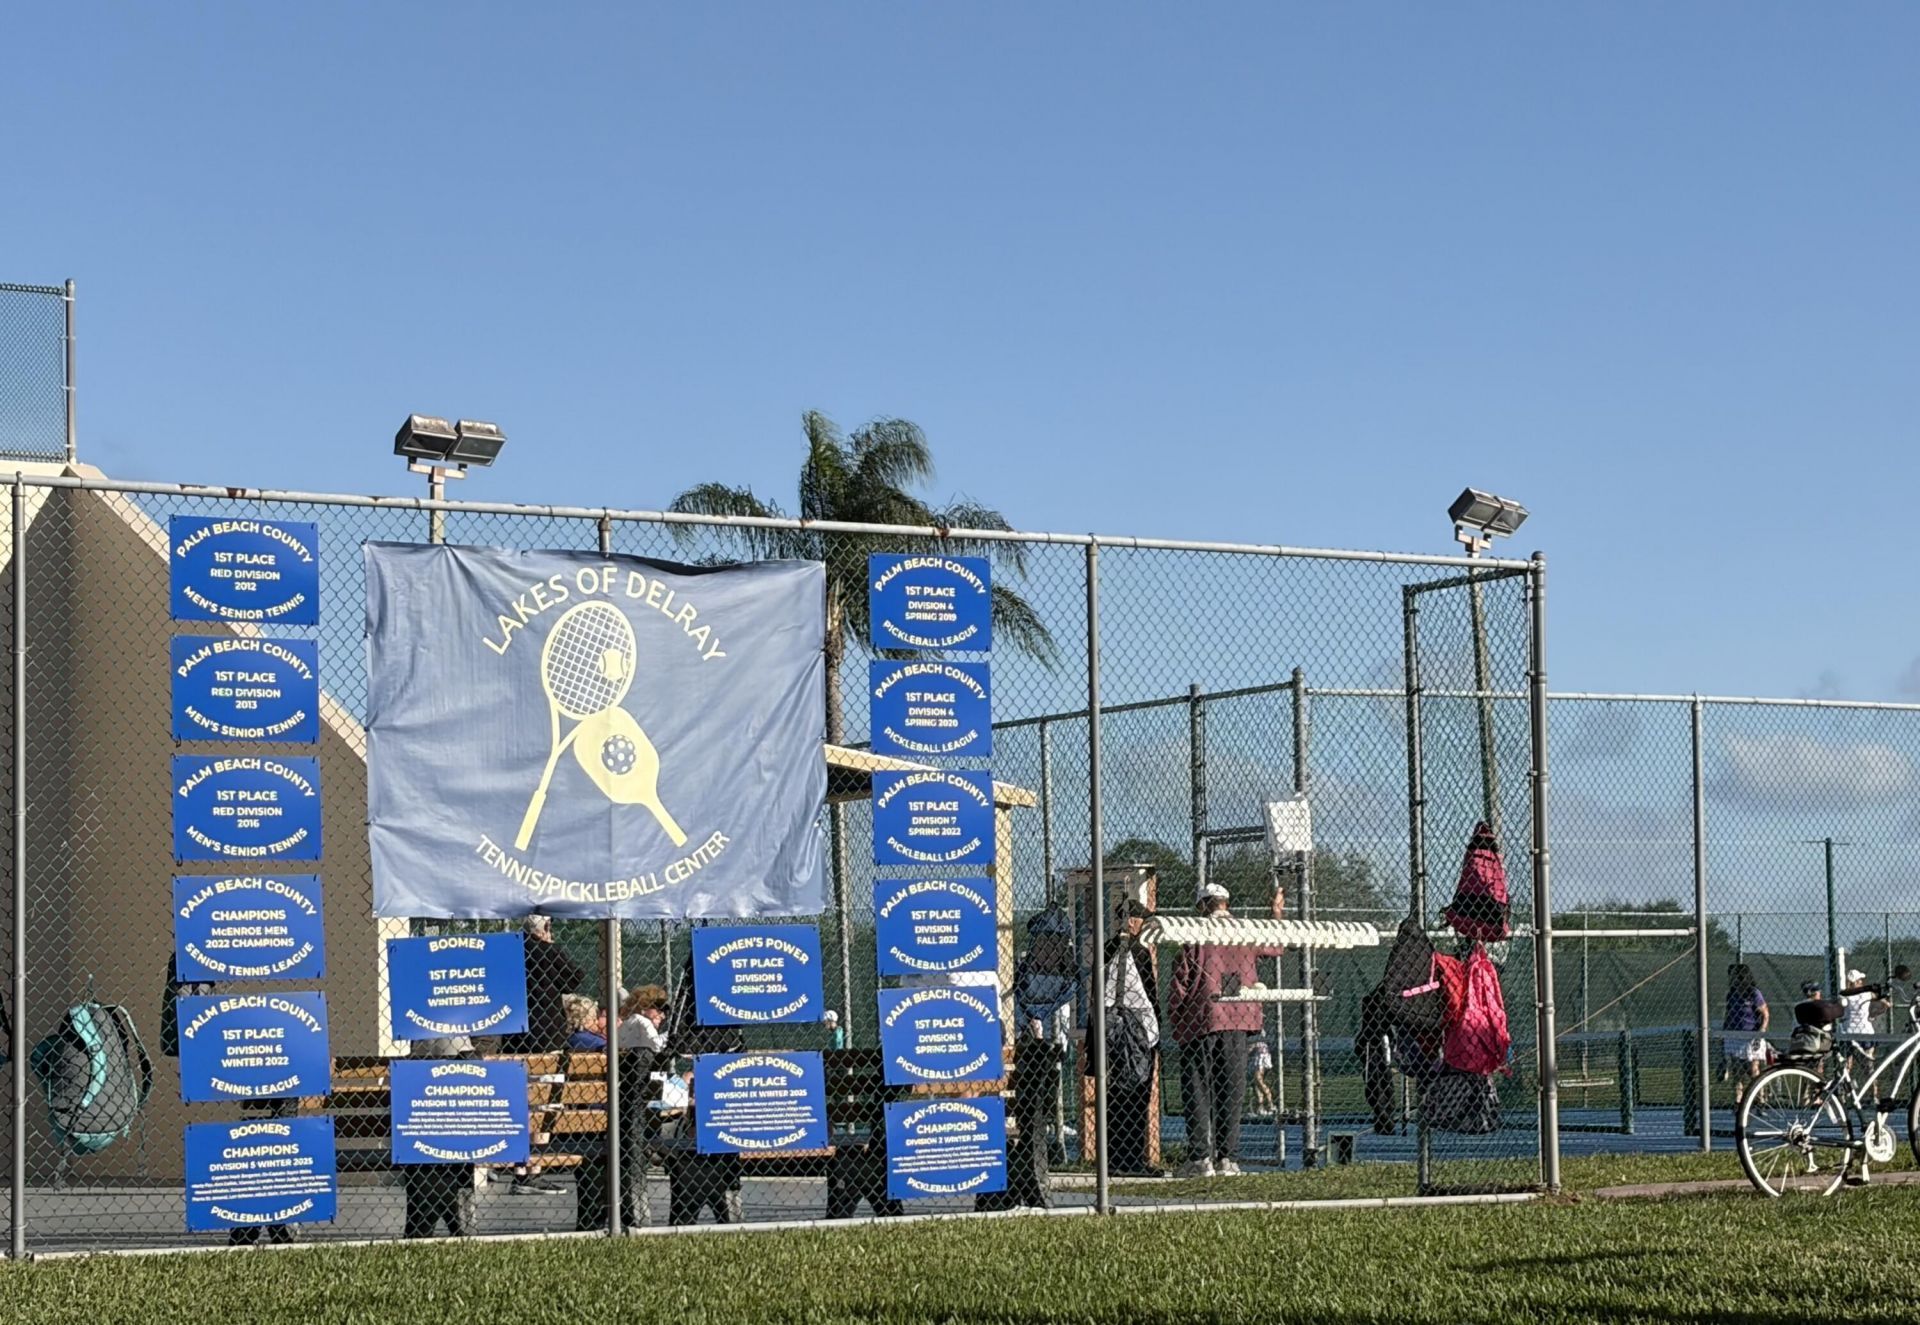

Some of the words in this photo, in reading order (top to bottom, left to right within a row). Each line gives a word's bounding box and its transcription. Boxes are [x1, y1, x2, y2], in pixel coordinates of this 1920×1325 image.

[177, 528, 211, 557] PALM
[212, 521, 259, 534] BEACH
[263, 526, 313, 563] COUNTY
[214, 552, 233, 562] 1ST
[237, 554, 275, 565] PLACE
[210, 568, 232, 577] RED
[235, 570, 280, 580] DIVISION
[875, 563, 902, 591] PALM
[904, 558, 942, 570] BEACH
[945, 561, 986, 594] COUNTY
[234, 582, 257, 591] 2012
[905, 586, 921, 596] 1ST
[924, 587, 955, 596] PLACE
[183, 586, 218, 613] MEN'S
[220, 606, 263, 619] SENIOR
[266, 593, 305, 617] TENNIS
[908, 601, 946, 610] DIVISION
[483, 574, 569, 656] LAKES
[576, 567, 618, 595] OF
[626, 571, 727, 663] DELRAY
[905, 612, 938, 620] SPRING
[883, 620, 940, 646] PICKLEBALL
[942, 625, 978, 646] LEAGUE
[178, 646, 212, 677] PALM
[213, 640, 259, 653] BEACH
[263, 643, 313, 680] COUNTY
[215, 671, 234, 681] 1ST
[237, 672, 276, 682] PLACE
[875, 670, 903, 698] PALM
[904, 664, 942, 676] BEACH
[945, 666, 987, 699] COUNTY
[211, 688, 233, 696] RED
[235, 689, 280, 698] DIVISION
[905, 692, 921, 702] 1ST
[924, 693, 955, 702] PLACE
[235, 700, 257, 709] 2013
[909, 707, 946, 716] DIVISION
[185, 706, 219, 732] MEN'S
[221, 725, 265, 738] SENIOR
[267, 710, 306, 736] TENNIS
[905, 719, 938, 727] SPRING
[939, 719, 958, 727] 2020
[884, 726, 940, 752] PICKLEBALL
[942, 729, 978, 752] LEAGUE
[179, 766, 212, 798] PALM
[214, 759, 260, 773] BEACH
[264, 762, 315, 797] COUNTY
[217, 790, 236, 801] 1ST
[239, 791, 278, 801] PLACE
[878, 779, 905, 808] PALM
[907, 772, 944, 786] BEACH
[948, 775, 989, 807] COUNTY
[213, 807, 234, 816] RED
[237, 807, 282, 816] DIVISION
[909, 802, 924, 811] 1ST
[927, 802, 959, 811] PLACE
[237, 819, 260, 828] 2016
[186, 826, 221, 851] MEN'S
[223, 845, 266, 856] SENIOR
[268, 827, 308, 854] TENNIS
[887, 837, 944, 862] PICKLEBALL
[946, 837, 981, 860] LEAGUE
[475, 834, 664, 902] TENNIS/PICKLEBALL
[664, 830, 730, 885] CENTER
[180, 886, 213, 918] PALM
[215, 878, 261, 893] BEACH
[265, 880, 317, 916] COUNTY
[881, 889, 908, 918] PALM
[909, 881, 947, 894] BEACH
[950, 883, 992, 915] COUNTY
[211, 910, 286, 921] CHAMPIONS
[911, 910, 926, 920] 1ST
[930, 910, 961, 919] PLACE
[265, 926, 287, 935] MEN
[915, 925, 952, 933] DIVISION
[205, 940, 230, 948] 2022
[232, 938, 294, 948] CHAMPIONS
[429, 938, 485, 952] BOOMER
[707, 937, 763, 964] WOMEN'S
[766, 938, 809, 964] POWER
[185, 943, 226, 973] SENIOR
[229, 965, 270, 976] TENNIS
[272, 942, 314, 972] LEAGUE
[731, 959, 747, 968] 1ST
[750, 958, 784, 967] PLACE
[890, 946, 947, 970] PICKLEBALL
[948, 945, 984, 968] LEAGUE
[429, 970, 447, 980] 1ST
[450, 968, 486, 979] PLACE
[735, 974, 775, 982] DIVISION
[433, 985, 476, 995] DIVISION
[731, 985, 765, 994] SPRING
[428, 997, 466, 1007] WINTER
[468, 996, 491, 1005] 2024
[709, 996, 770, 1020] PICKLEBALL
[771, 994, 809, 1019] LEAGUE
[885, 997, 912, 1027] PALM
[913, 989, 950, 1003] BEACH
[954, 991, 996, 1023] COUNTY
[184, 1006, 218, 1038] PALM
[220, 996, 266, 1012] BEACH
[270, 998, 322, 1033] COUNTY
[406, 1009, 470, 1033] PICKLEBALL
[472, 1005, 512, 1031] LEAGUE
[915, 1019, 930, 1029] 1ST
[933, 1018, 964, 1028] PLACE
[222, 1030, 242, 1040] 1ST
[245, 1028, 284, 1038] PLACE
[919, 1034, 956, 1043] DIVISION
[227, 1045, 273, 1055] DIVISION
[915, 1045, 946, 1054] SPRING
[221, 1058, 263, 1068] WINTER
[265, 1057, 289, 1066] 2022
[714, 1056, 763, 1079] WOMEN'S
[765, 1057, 804, 1078] POWER
[896, 1056, 953, 1079] PICKLEBALL
[955, 1052, 989, 1077] LEAGUE
[431, 1064, 487, 1078] BOOMERS
[211, 1078, 252, 1095] TENNIS
[255, 1075, 300, 1095] LEAGUE
[733, 1078, 750, 1087] 1ST
[753, 1077, 787, 1086] PLACE
[425, 1086, 495, 1096] CHAMPIONS
[759, 1090, 788, 1098] WINTER
[411, 1100, 447, 1108] DIVISION
[229, 1123, 290, 1139] BOOMERS
[917, 1121, 977, 1134] CHAMPIONS
[718, 1131, 772, 1148] PICKLEBALL
[774, 1128, 807, 1147] LEAGUE
[223, 1144, 299, 1158] CHAMPIONS
[413, 1140, 470, 1160] PICKLEBALL
[472, 1139, 508, 1158] LEAGUE
[209, 1162, 248, 1172] DIVISION
[258, 1159, 292, 1168] WINTER
[907, 1177, 956, 1192] PICKLEBALL
[958, 1171, 989, 1190] LEAGUE
[211, 1206, 272, 1223] PICKLEBALL
[275, 1199, 313, 1220] LEAGUE
